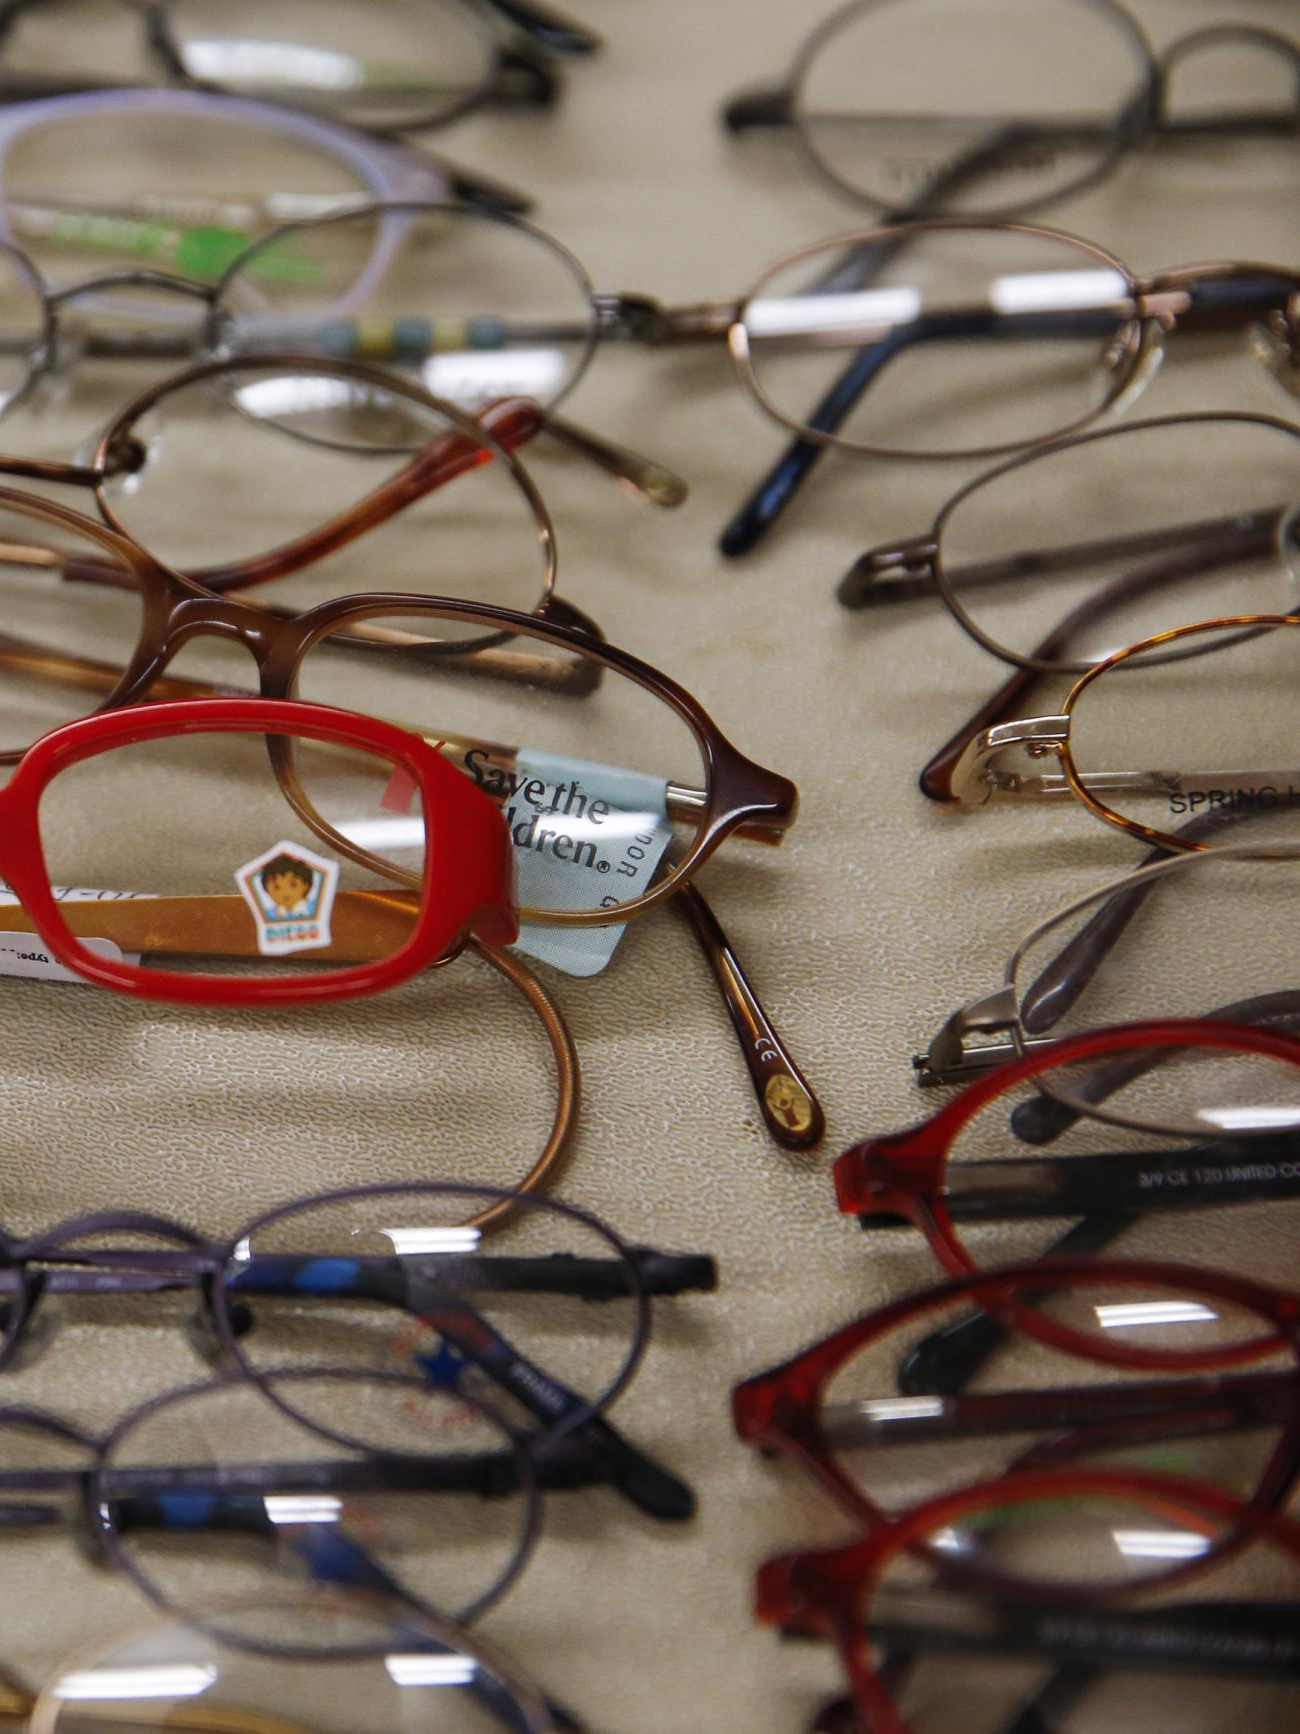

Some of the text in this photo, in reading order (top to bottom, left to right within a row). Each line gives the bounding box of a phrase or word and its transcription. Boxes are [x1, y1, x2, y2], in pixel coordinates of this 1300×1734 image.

[463, 748, 611, 825] Save the
[1170, 786, 1277, 814] SPRING
[755, 1038, 778, 1062] CE
